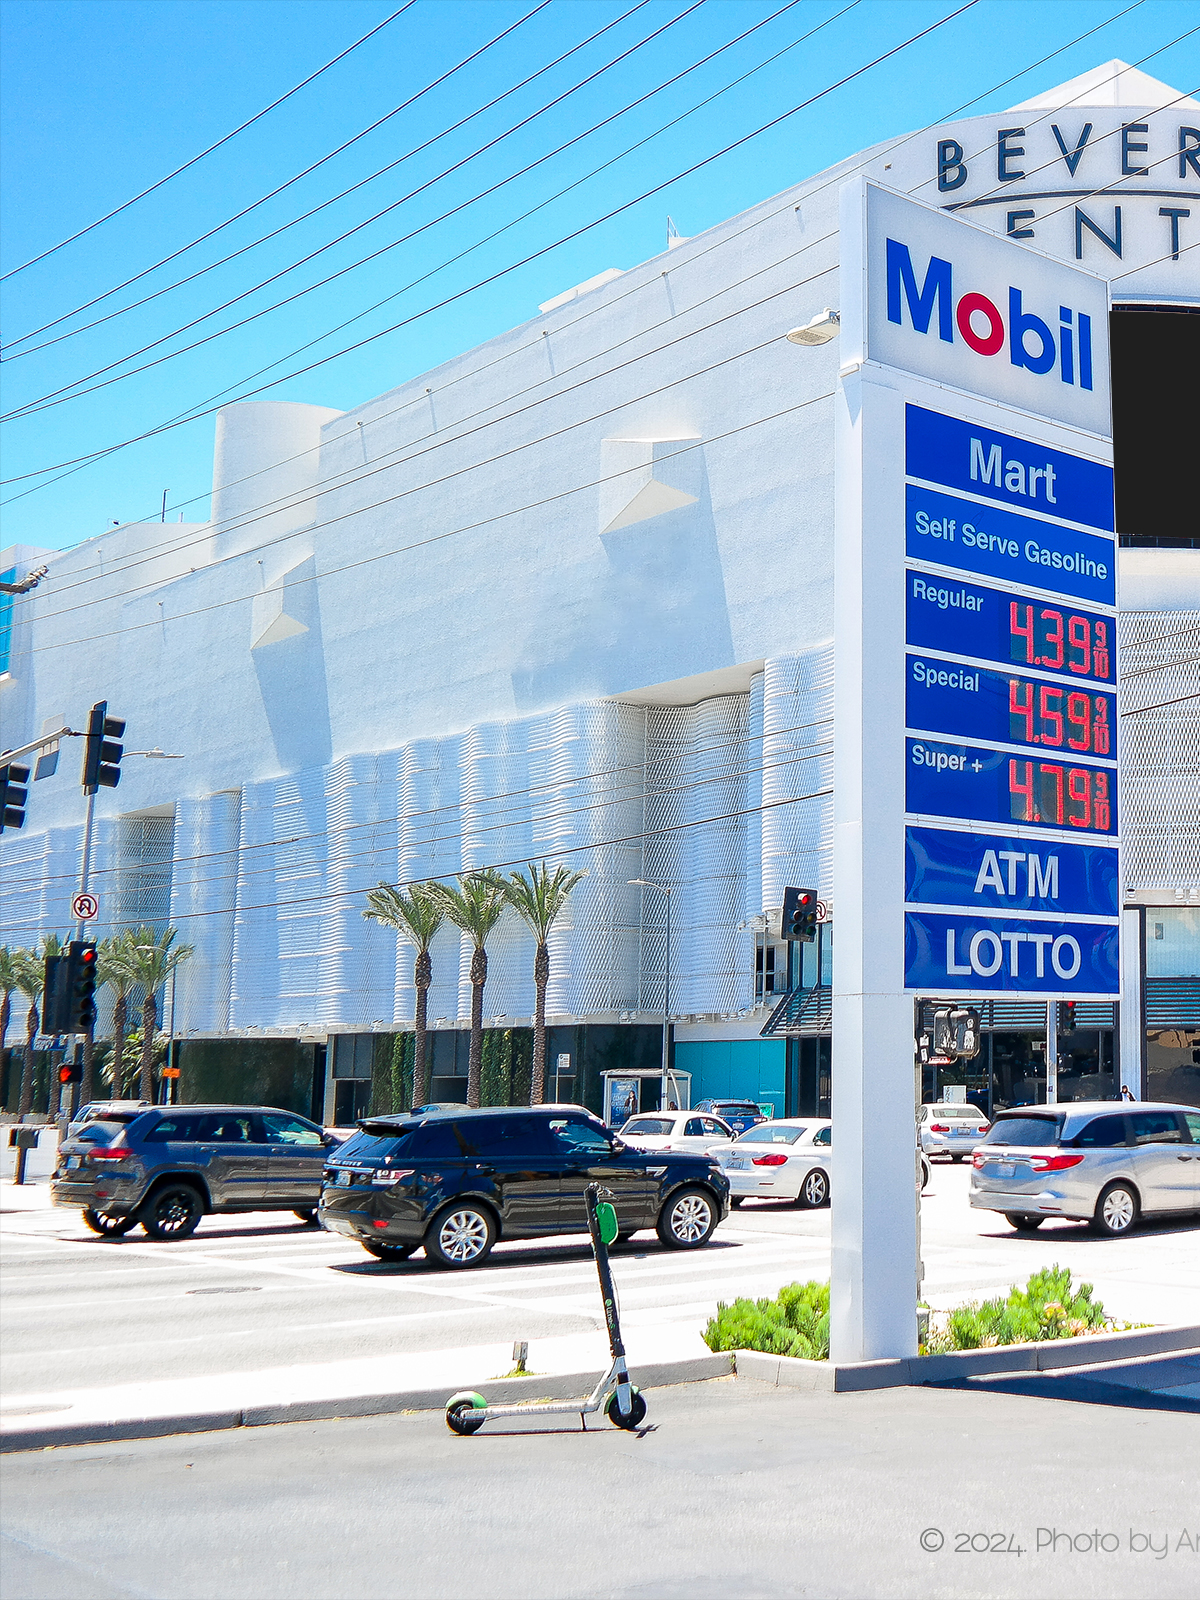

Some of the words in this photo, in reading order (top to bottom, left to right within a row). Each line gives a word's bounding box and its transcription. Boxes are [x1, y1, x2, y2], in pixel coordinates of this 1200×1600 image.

[886, 237, 1094, 392] Mobil
[969, 436, 1057, 504] Mart
[915, 510, 956, 542] Self
[961, 523, 1020, 558] Serve
[1024, 540, 1108, 580] Gasoline
[913, 578, 984, 612] Regular
[912, 661, 980, 692] Special
[912, 744, 967, 773] Super
[973, 849, 1059, 899] ATM
[946, 928, 1082, 980] LOTTO
